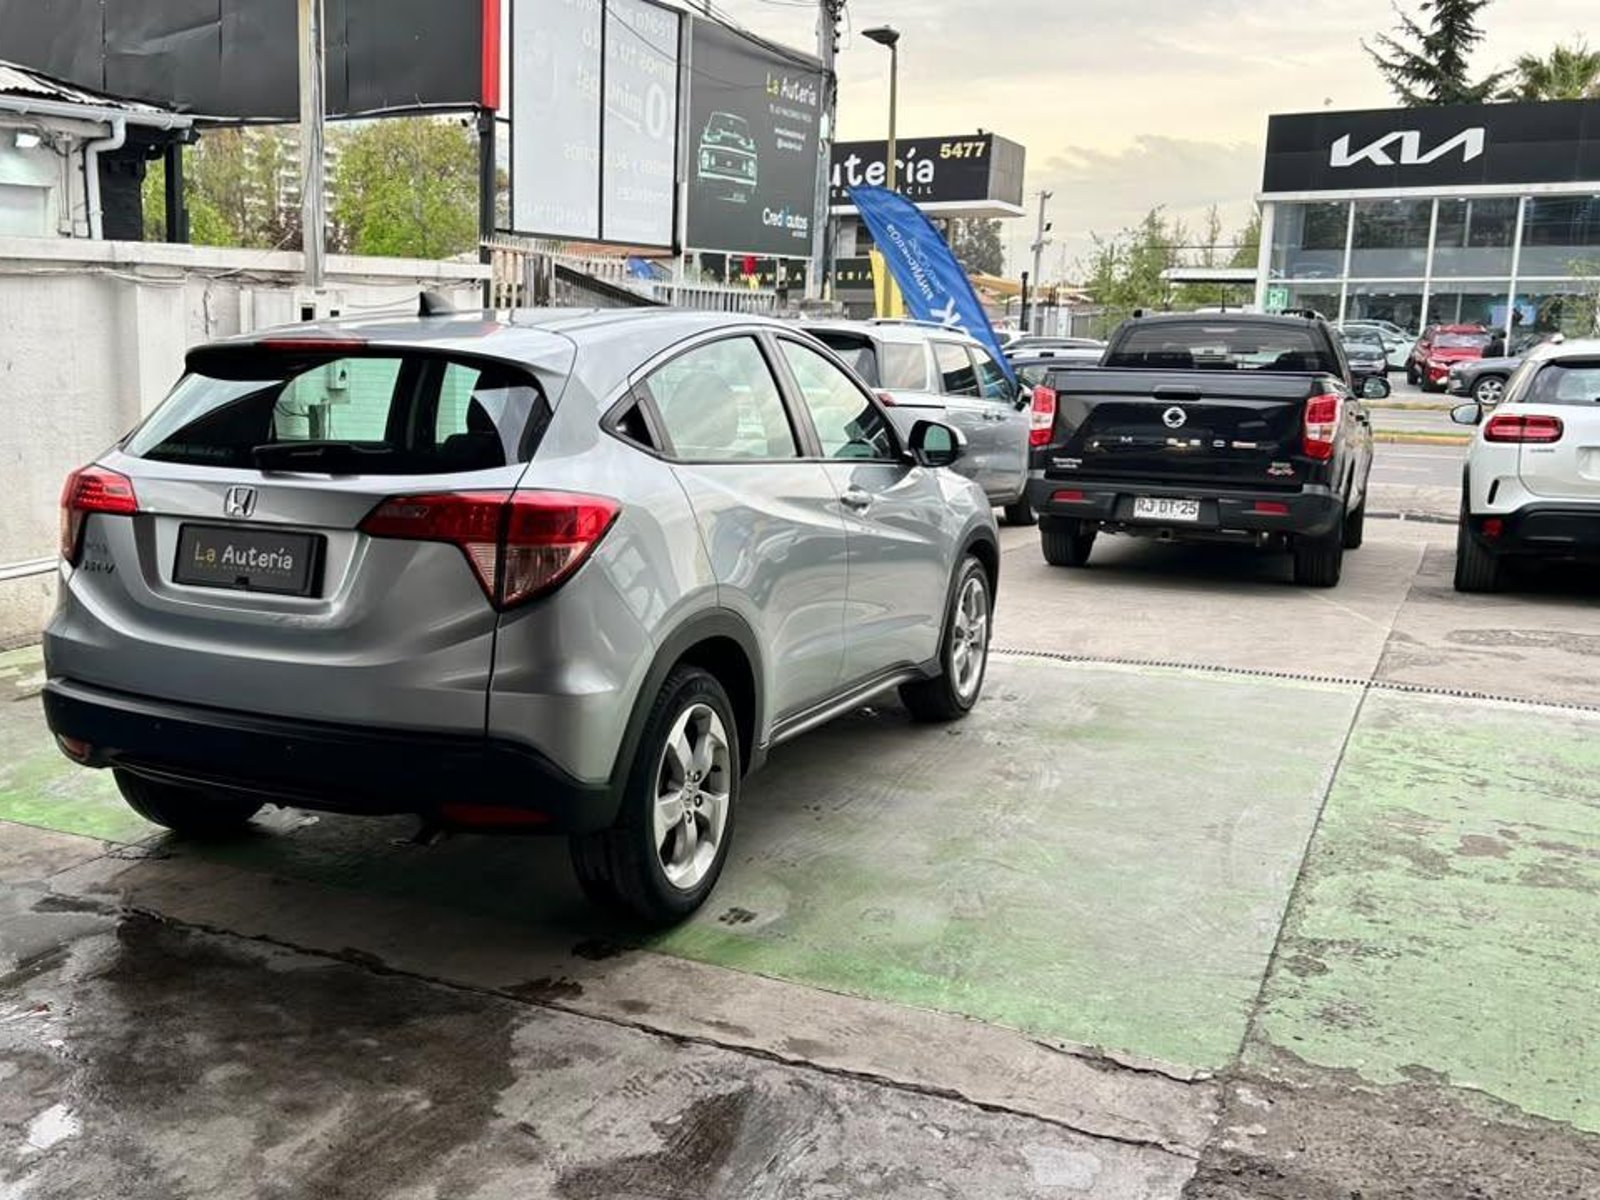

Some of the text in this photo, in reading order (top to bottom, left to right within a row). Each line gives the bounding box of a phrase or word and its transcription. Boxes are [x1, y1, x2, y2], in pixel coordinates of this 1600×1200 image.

[766, 72, 780, 95] La
[939, 141, 986, 159] 5477
[1329, 127, 1485, 167] KIA
[195, 541, 216, 562] La
[221, 545, 293, 569] Autería
